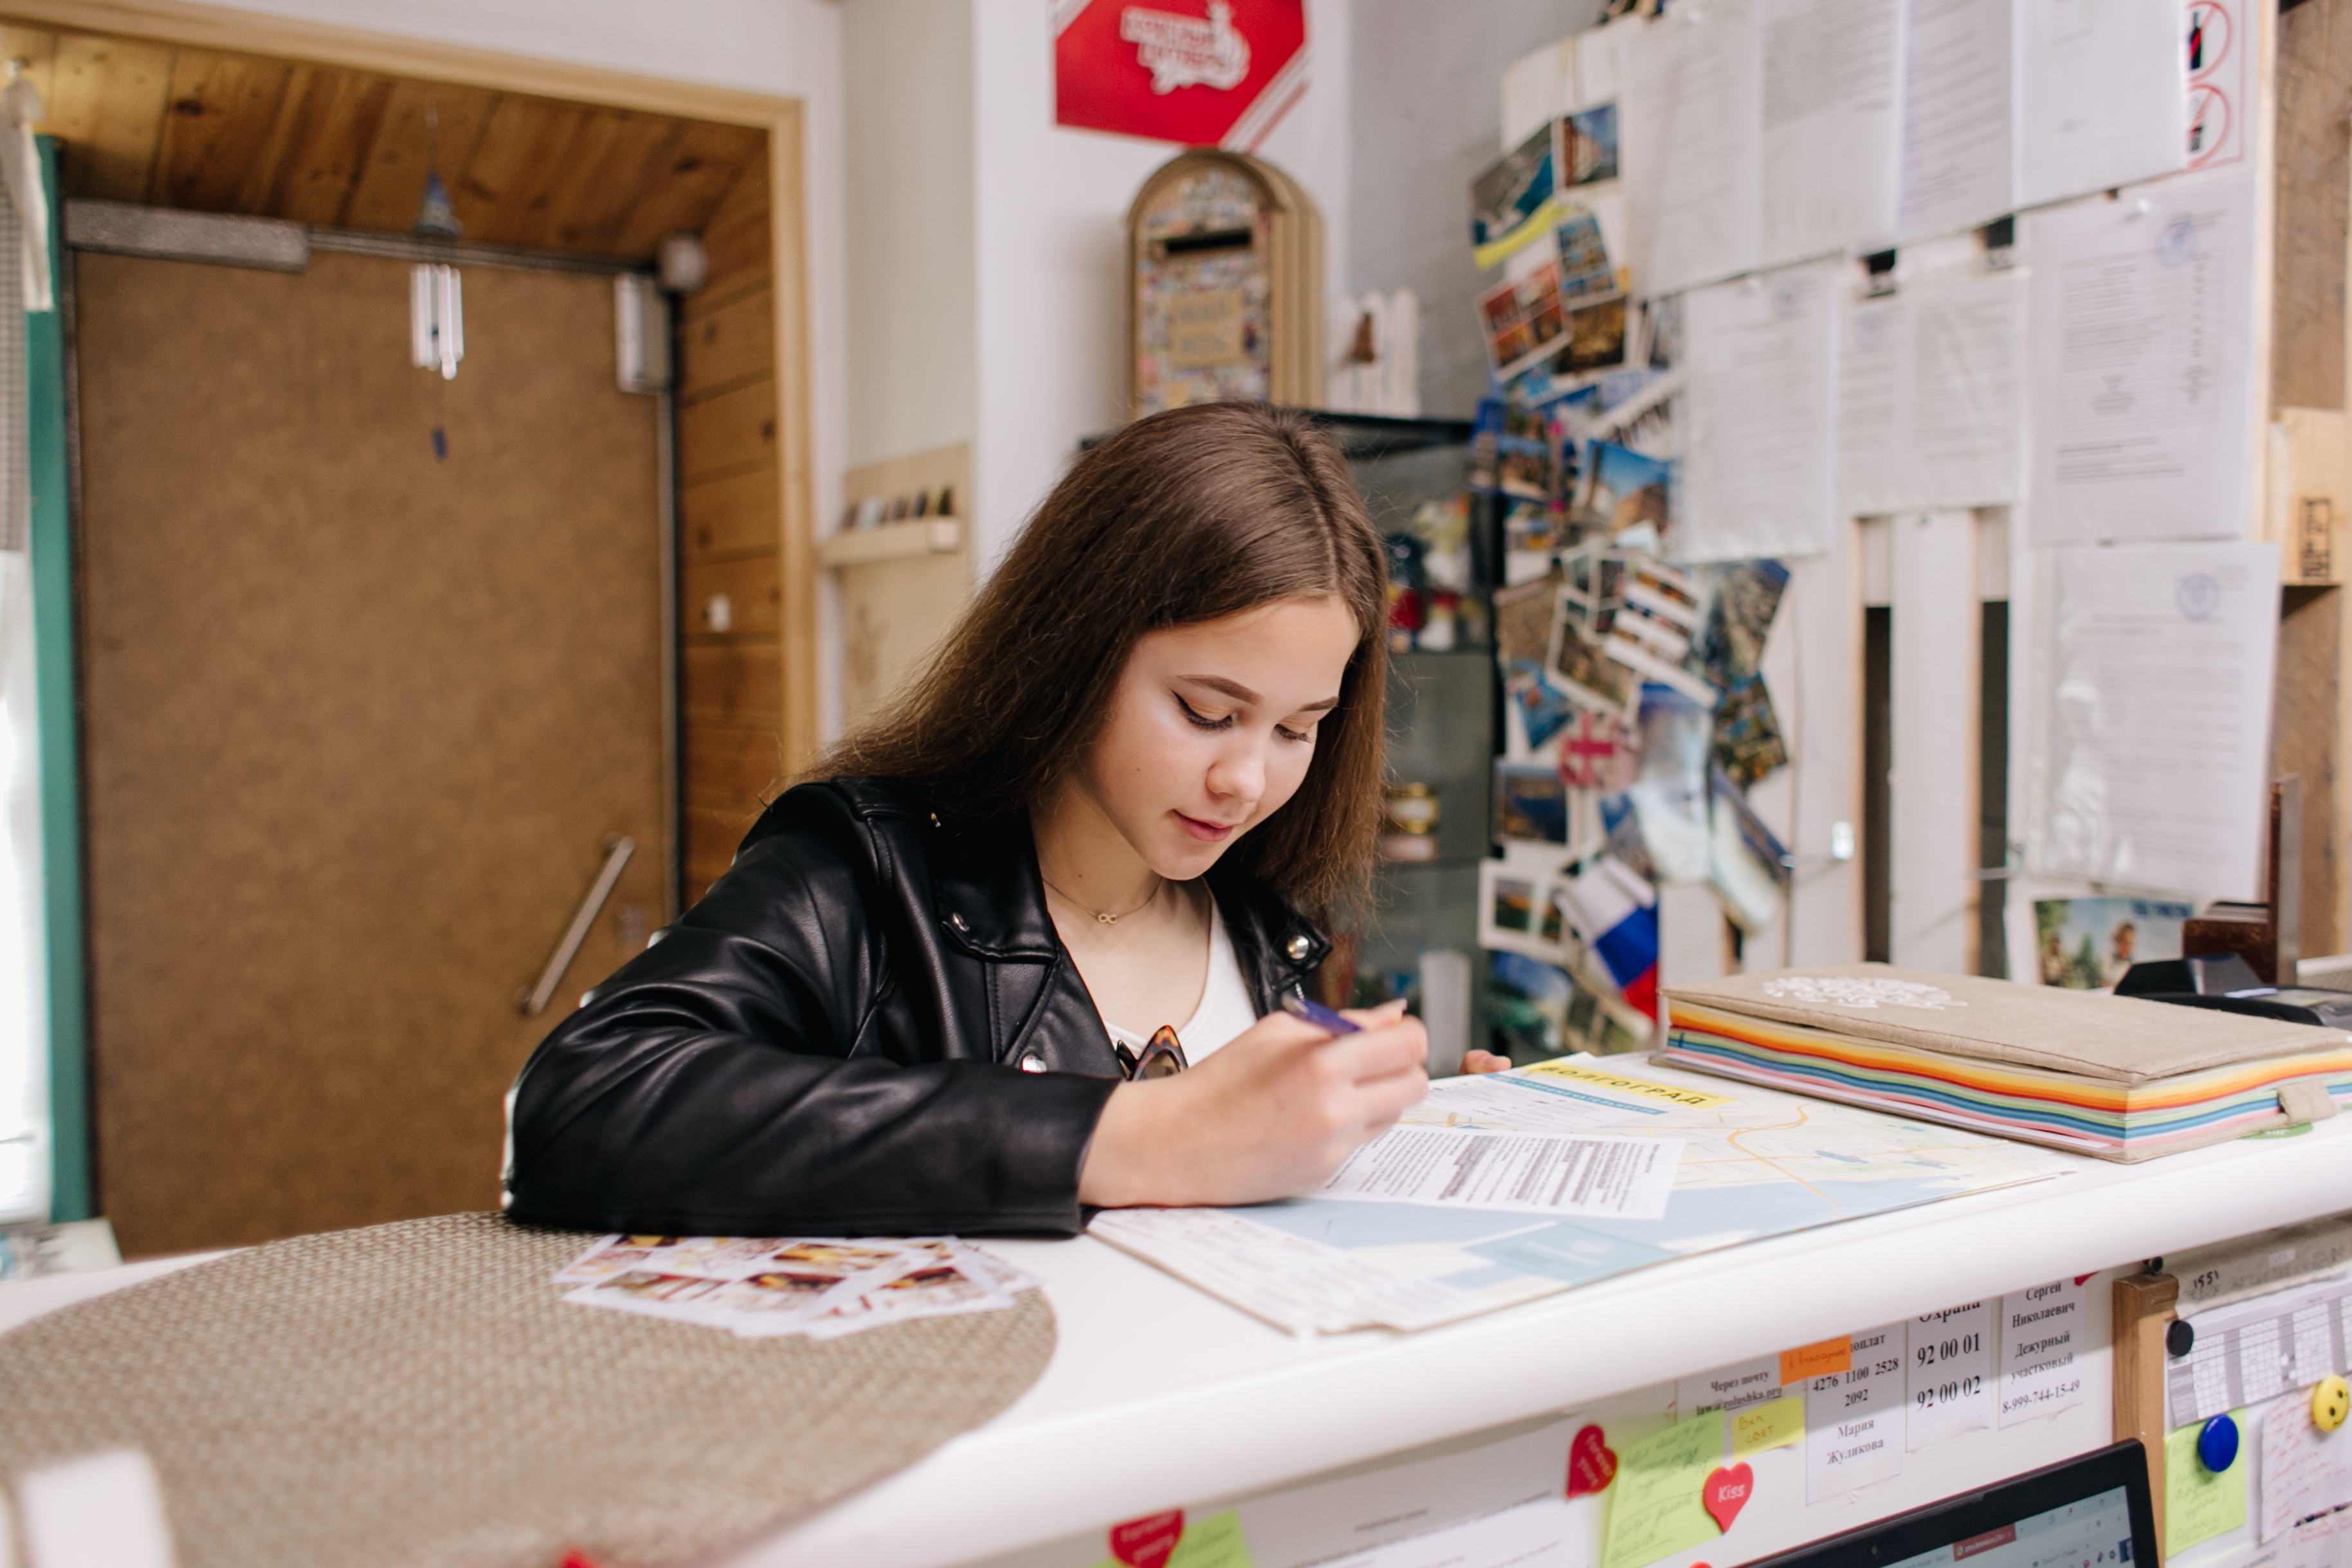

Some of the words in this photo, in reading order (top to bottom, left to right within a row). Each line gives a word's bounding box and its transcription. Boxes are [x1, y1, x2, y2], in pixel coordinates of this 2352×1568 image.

[1541, 1066, 1708, 1105] ВОЛГОГРАД
[2026, 1281, 2062, 1301] Сергей
[2012, 1302, 2075, 1329] Николаевич
[1850, 1334, 1886, 1354] оплат
[1917, 1345, 1935, 1368] 92
[1940, 1338, 1958, 1361] 00
[1963, 1332, 1981, 1354] 01
[2014, 1330, 2071, 1359] Дежурный
[1711, 1378, 1739, 1392] Через
[1741, 1371, 1770, 1385] почту
[1812, 1374, 1839, 1392] 4276
[1845, 1366, 1869, 1384] 1100
[1875, 1357, 1899, 1375] 2528
[2010, 1352, 2074, 1384] участковый
[1844, 1388, 1868, 1407] 2092
[1917, 1388, 1935, 1412] 92
[1939, 1381, 1958, 1403] 00
[1963, 1375, 1981, 1397] 02
[2002, 1379, 2081, 1414] 8-999-744-15-49
[1837, 1419, 1874, 1439] Мария
[1827, 1439, 1884, 1465] Жуликова
[1718, 1484, 1746, 1503] Kiss
